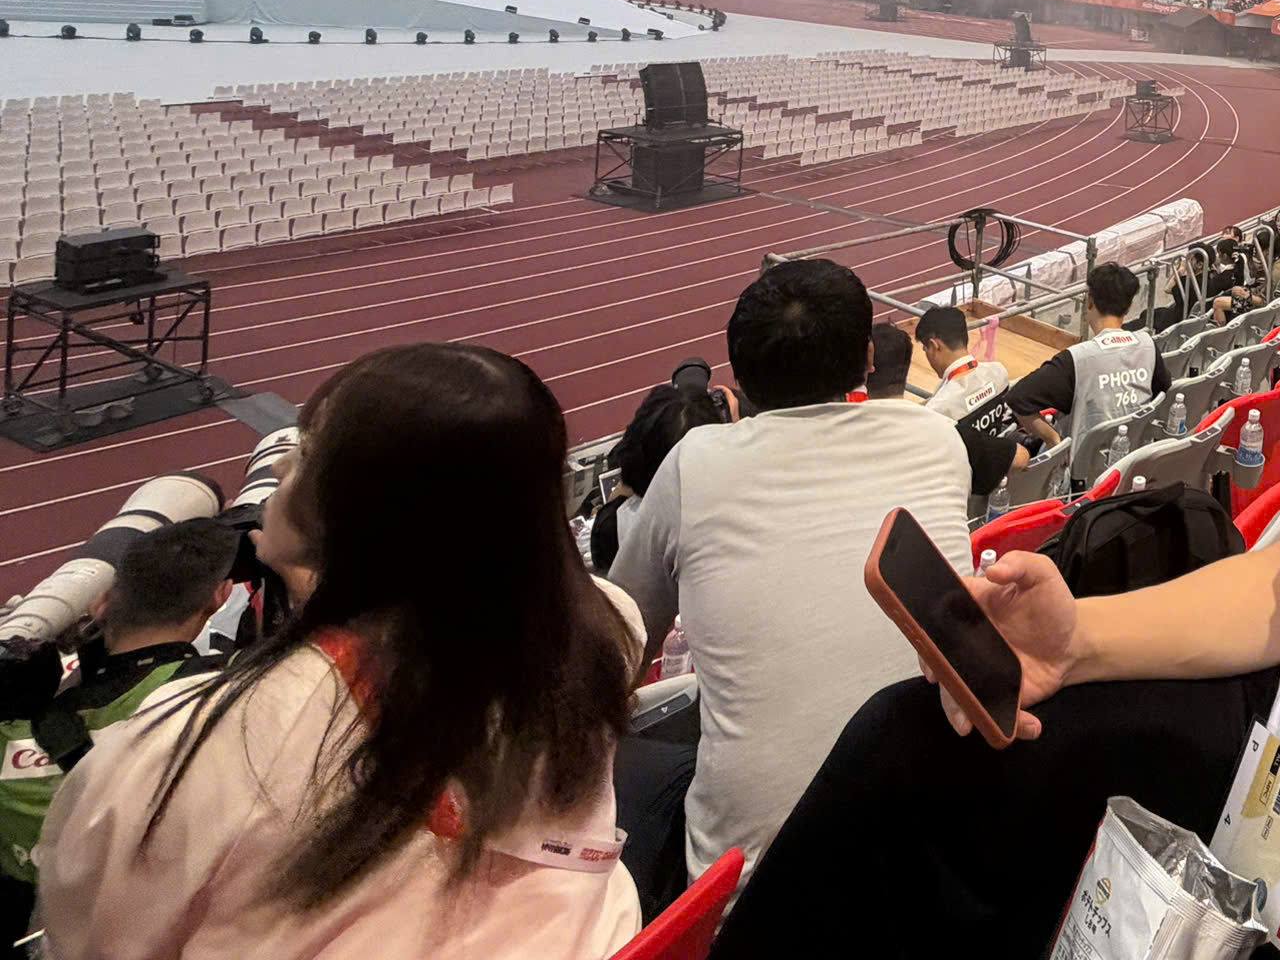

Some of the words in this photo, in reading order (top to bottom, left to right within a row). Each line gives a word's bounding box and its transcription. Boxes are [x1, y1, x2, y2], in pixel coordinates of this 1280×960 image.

[1101, 334, 1133, 345] Canon
[1098, 367, 1148, 389] PHOTO
[968, 386, 993, 406] Canon
[1115, 390, 1138, 407] 766
[1251, 739, 1259, 752] P
[1223, 813, 1231, 825] 4
